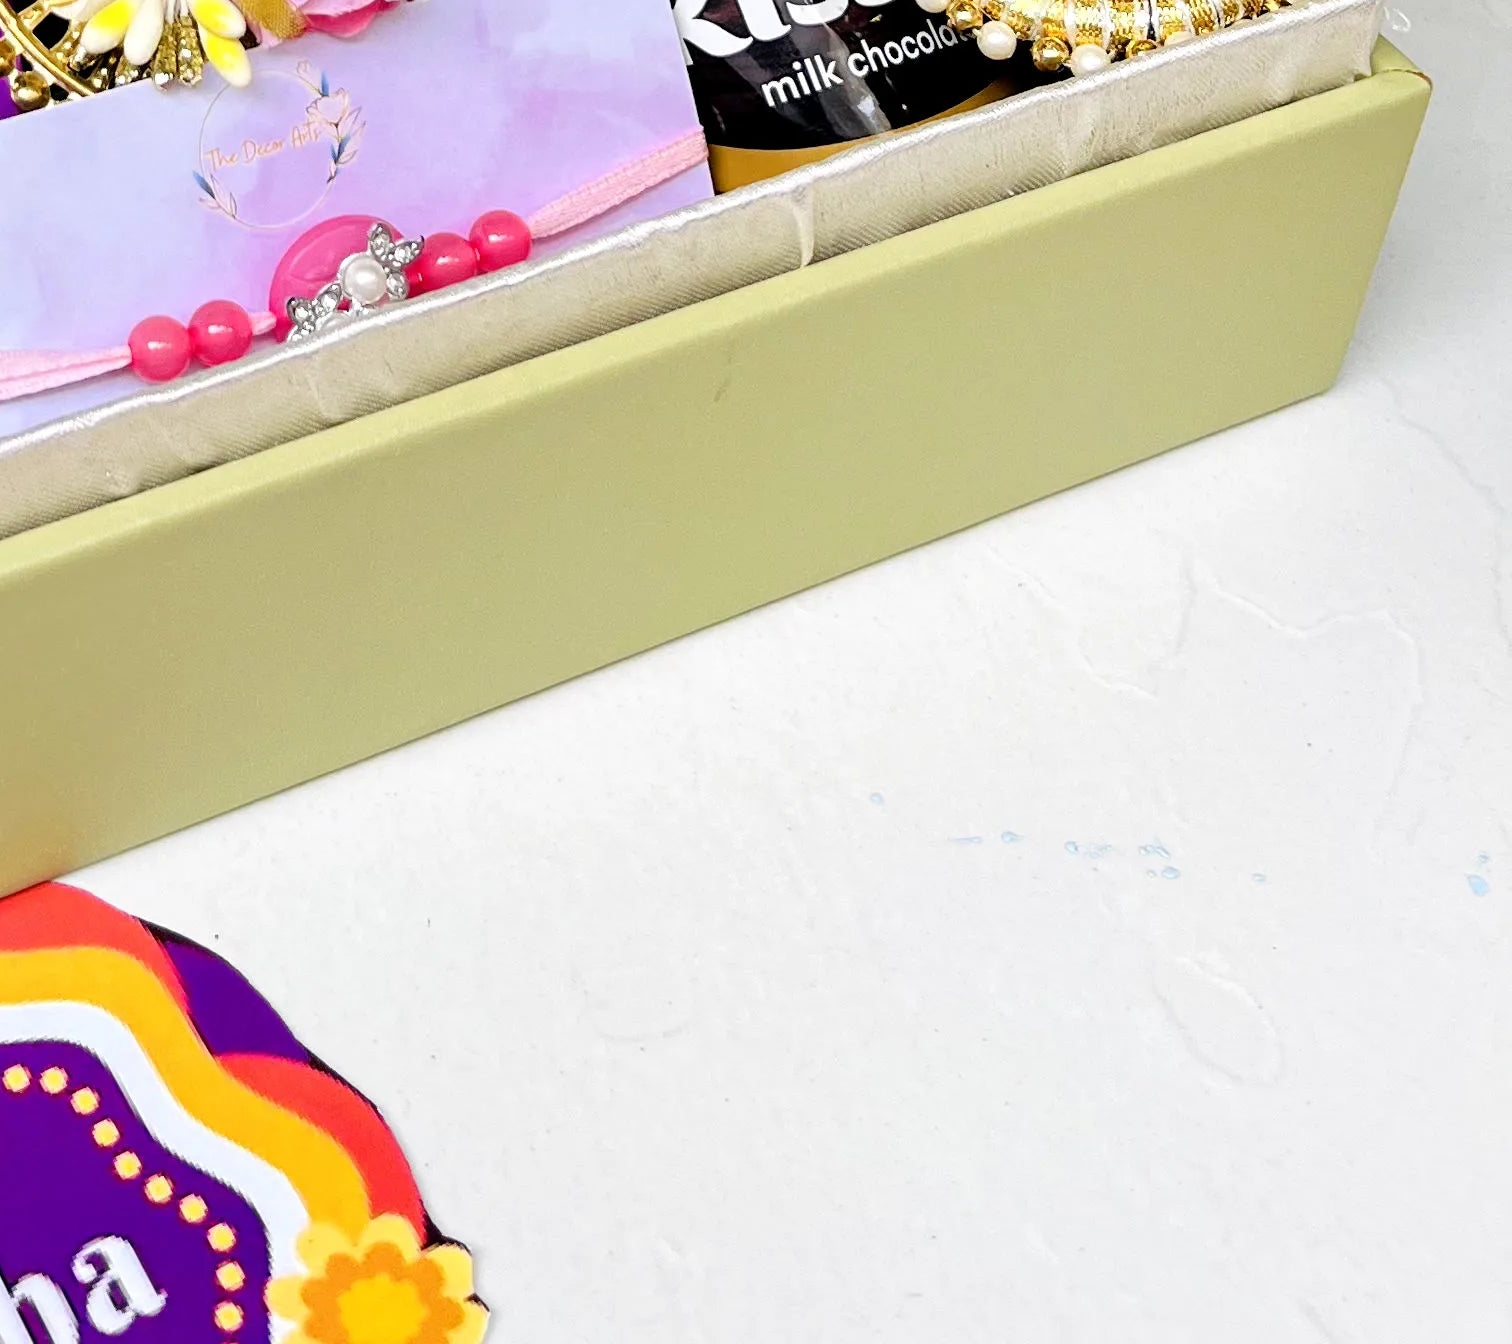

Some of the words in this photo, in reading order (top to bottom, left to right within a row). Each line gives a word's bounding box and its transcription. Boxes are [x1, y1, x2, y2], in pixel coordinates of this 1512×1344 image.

[761, 54, 844, 108] milk
[847, 18, 968, 79] chocola
[206, 147, 239, 171] The
[291, 122, 321, 148] Arts
